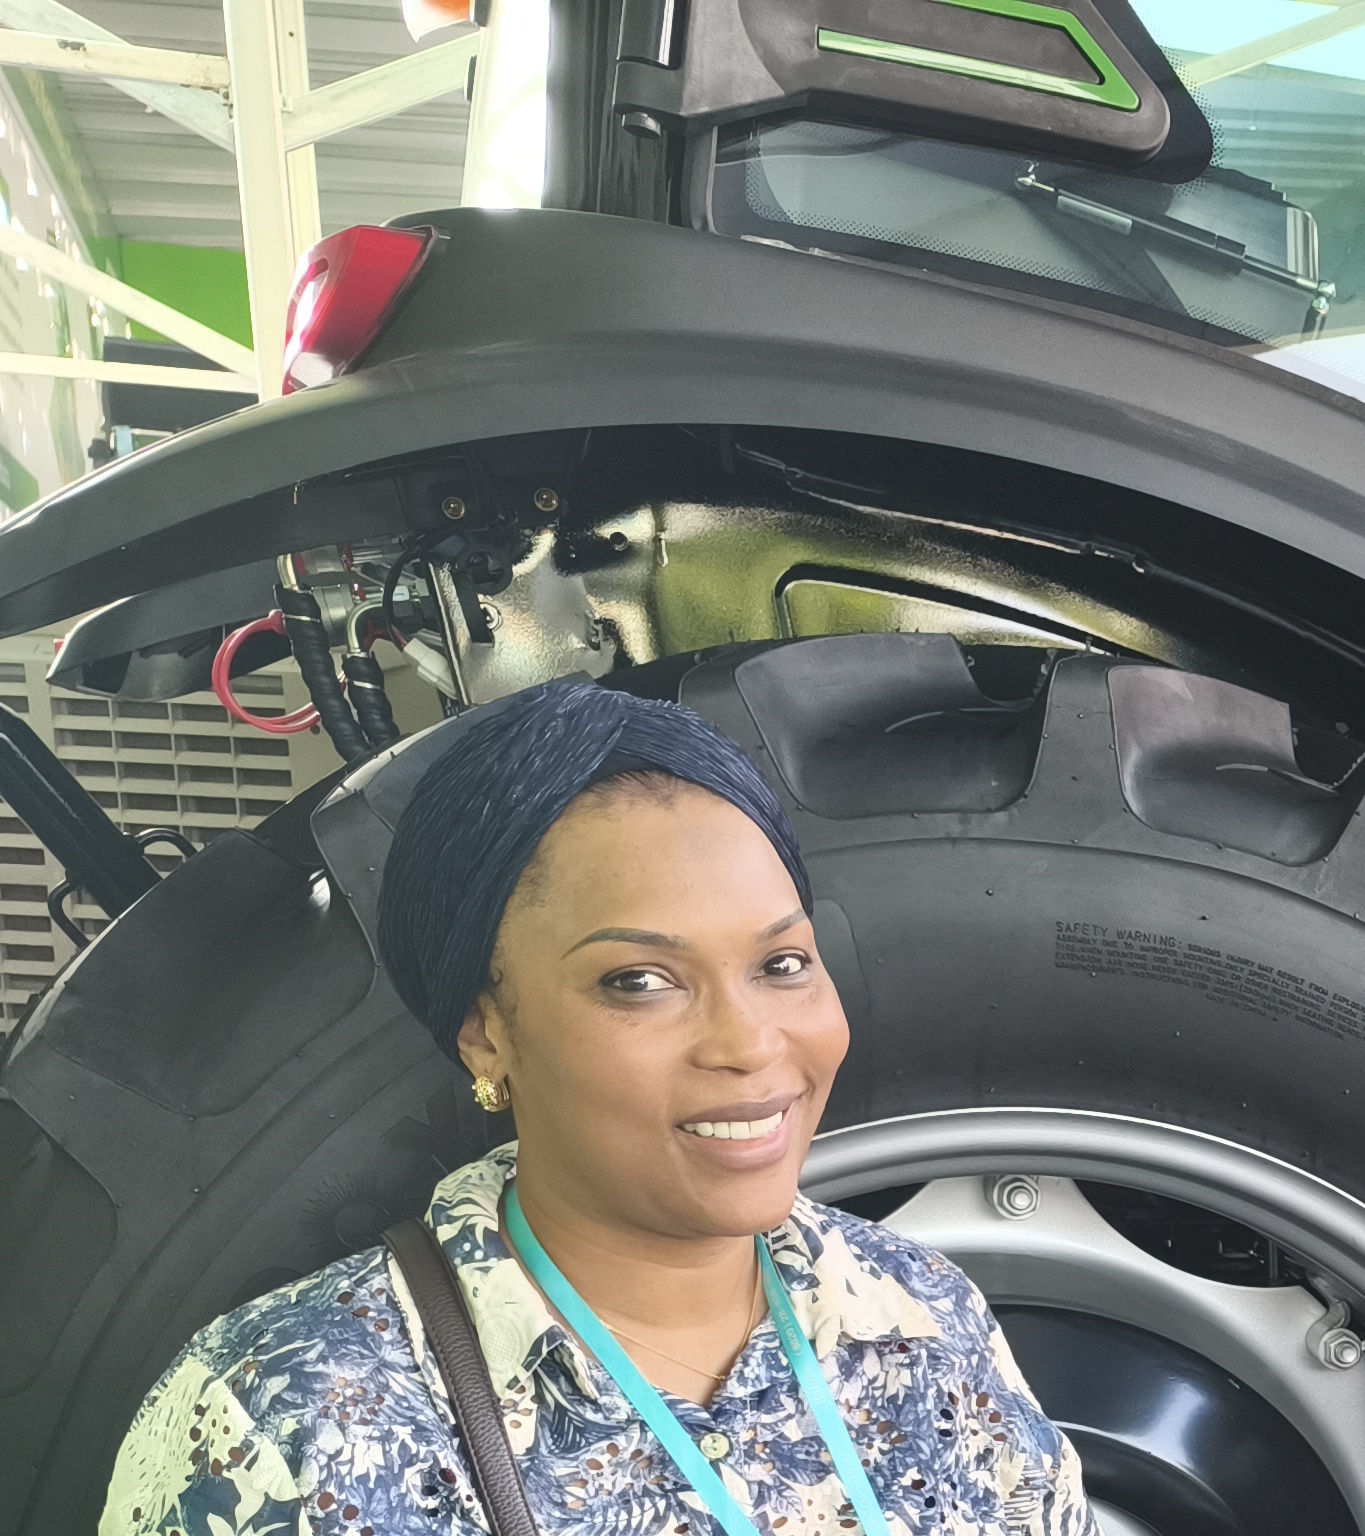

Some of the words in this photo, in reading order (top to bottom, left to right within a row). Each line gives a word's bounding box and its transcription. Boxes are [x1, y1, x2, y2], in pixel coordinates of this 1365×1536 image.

[1055, 921, 1108, 937] SAFETY
[1117, 928, 1182, 948] WARNING:
[1257, 962, 1274, 974] MAY
[1309, 982, 1328, 996] FROM
[1123, 941, 1134, 950] TO
[1248, 969, 1291, 989] SPECIALLY
